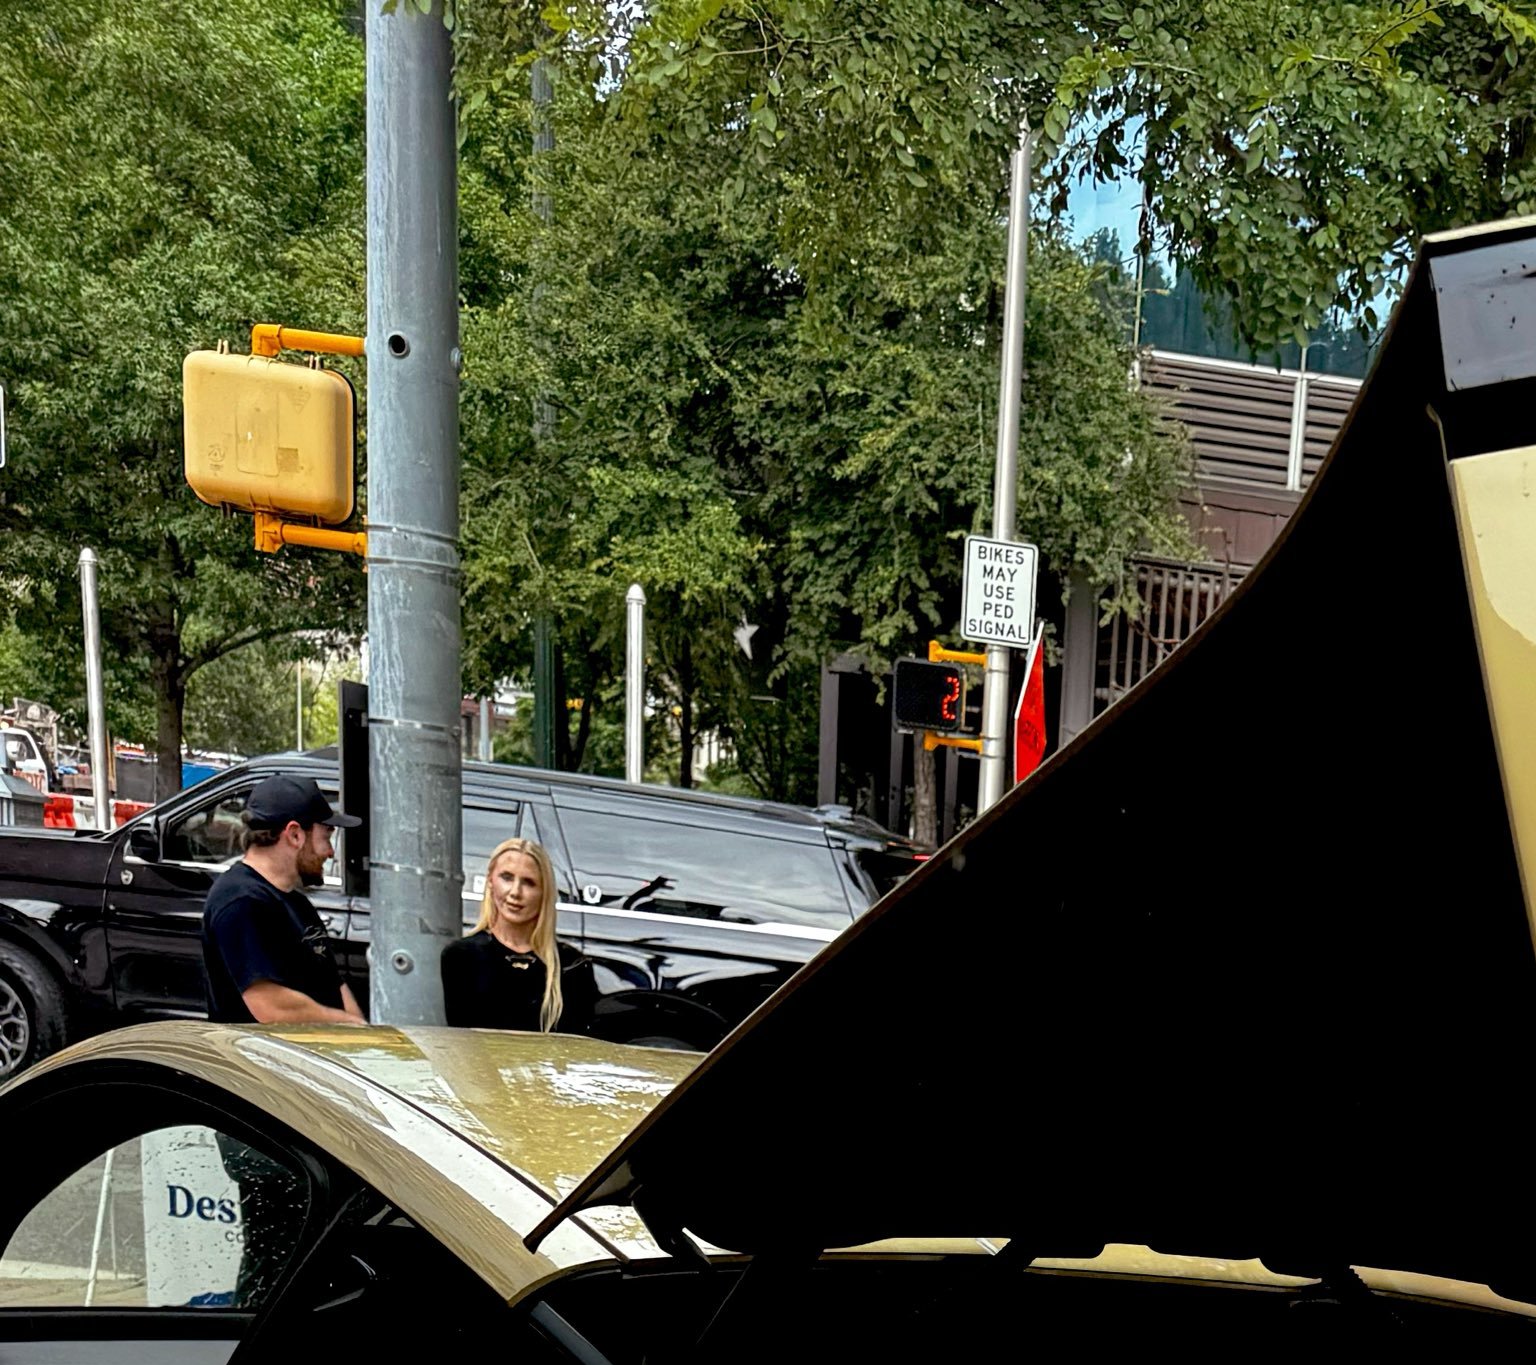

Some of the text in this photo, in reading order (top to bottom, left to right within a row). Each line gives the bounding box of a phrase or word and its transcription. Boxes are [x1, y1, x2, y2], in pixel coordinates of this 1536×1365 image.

[978, 546, 1024, 565] BIKES
[982, 565, 1017, 582] MAY
[983, 585, 1015, 601] USE
[983, 604, 1014, 618] PED
[968, 618, 1026, 640] SIGNAL
[943, 676, 960, 720] 2
[167, 1185, 237, 1224] Des
